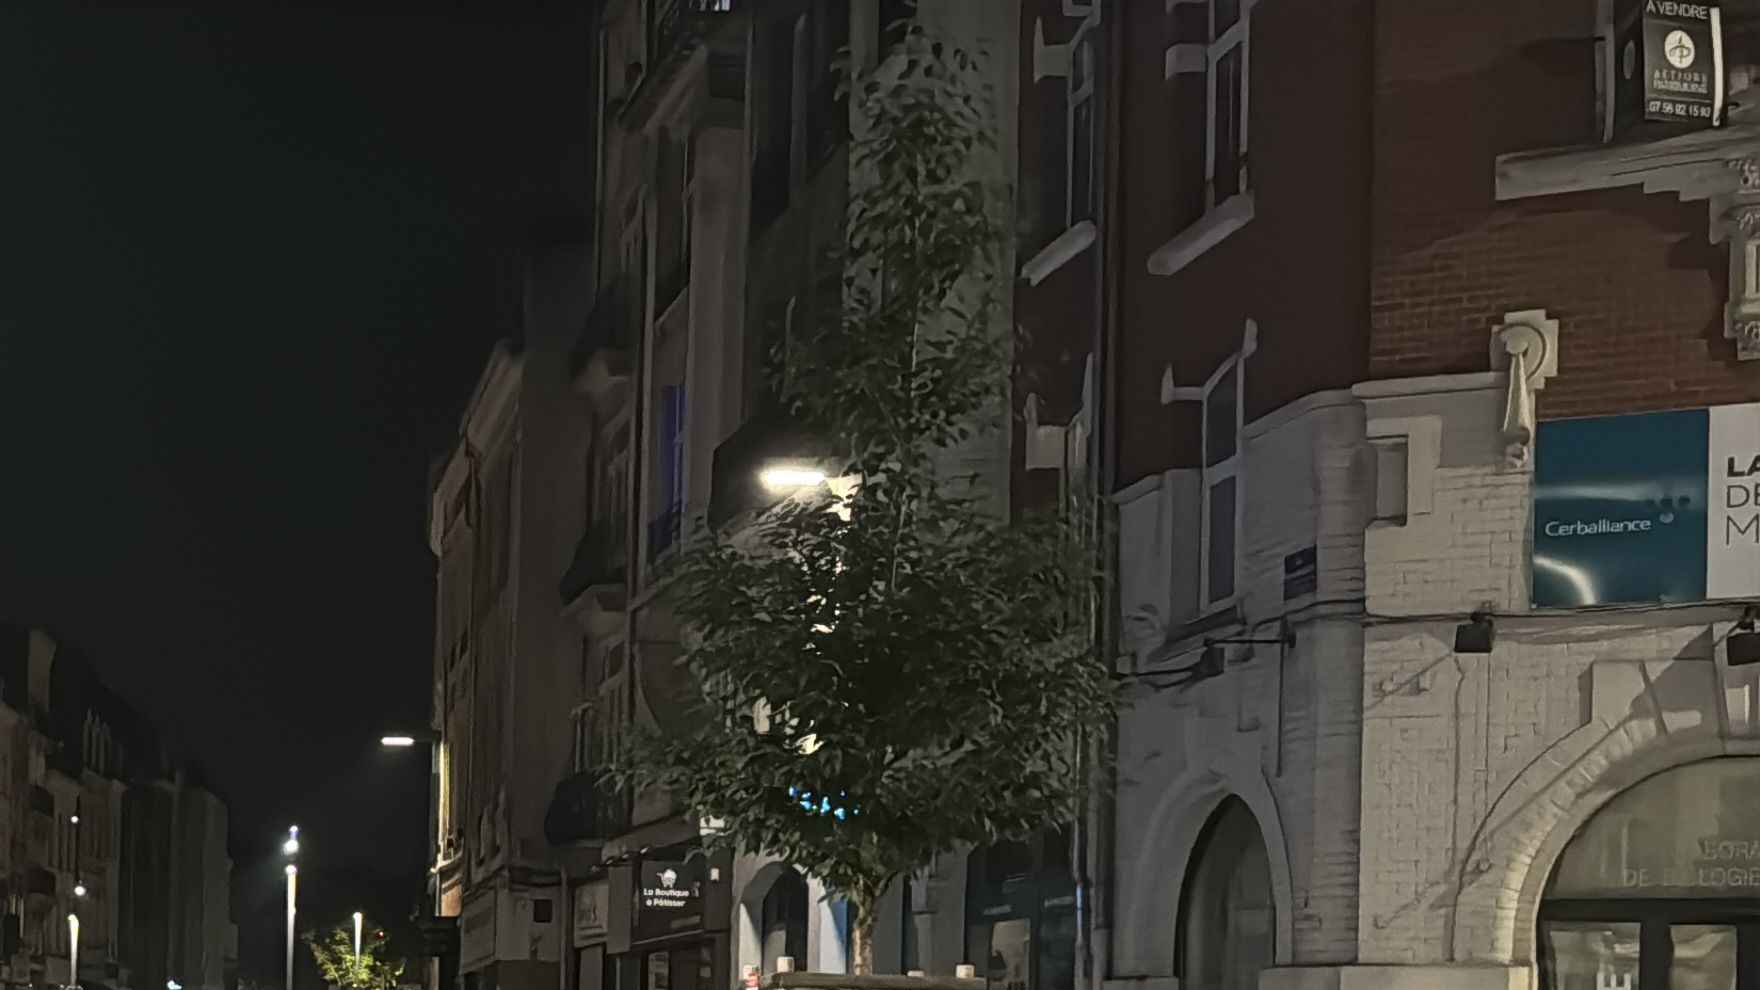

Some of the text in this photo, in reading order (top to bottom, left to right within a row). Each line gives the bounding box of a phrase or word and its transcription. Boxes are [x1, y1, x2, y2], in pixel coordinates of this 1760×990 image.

[1656, 1, 1708, 19] VENDRE
[1545, 519, 1651, 537] Cerballiance
[643, 887, 690, 897] La Boutique
